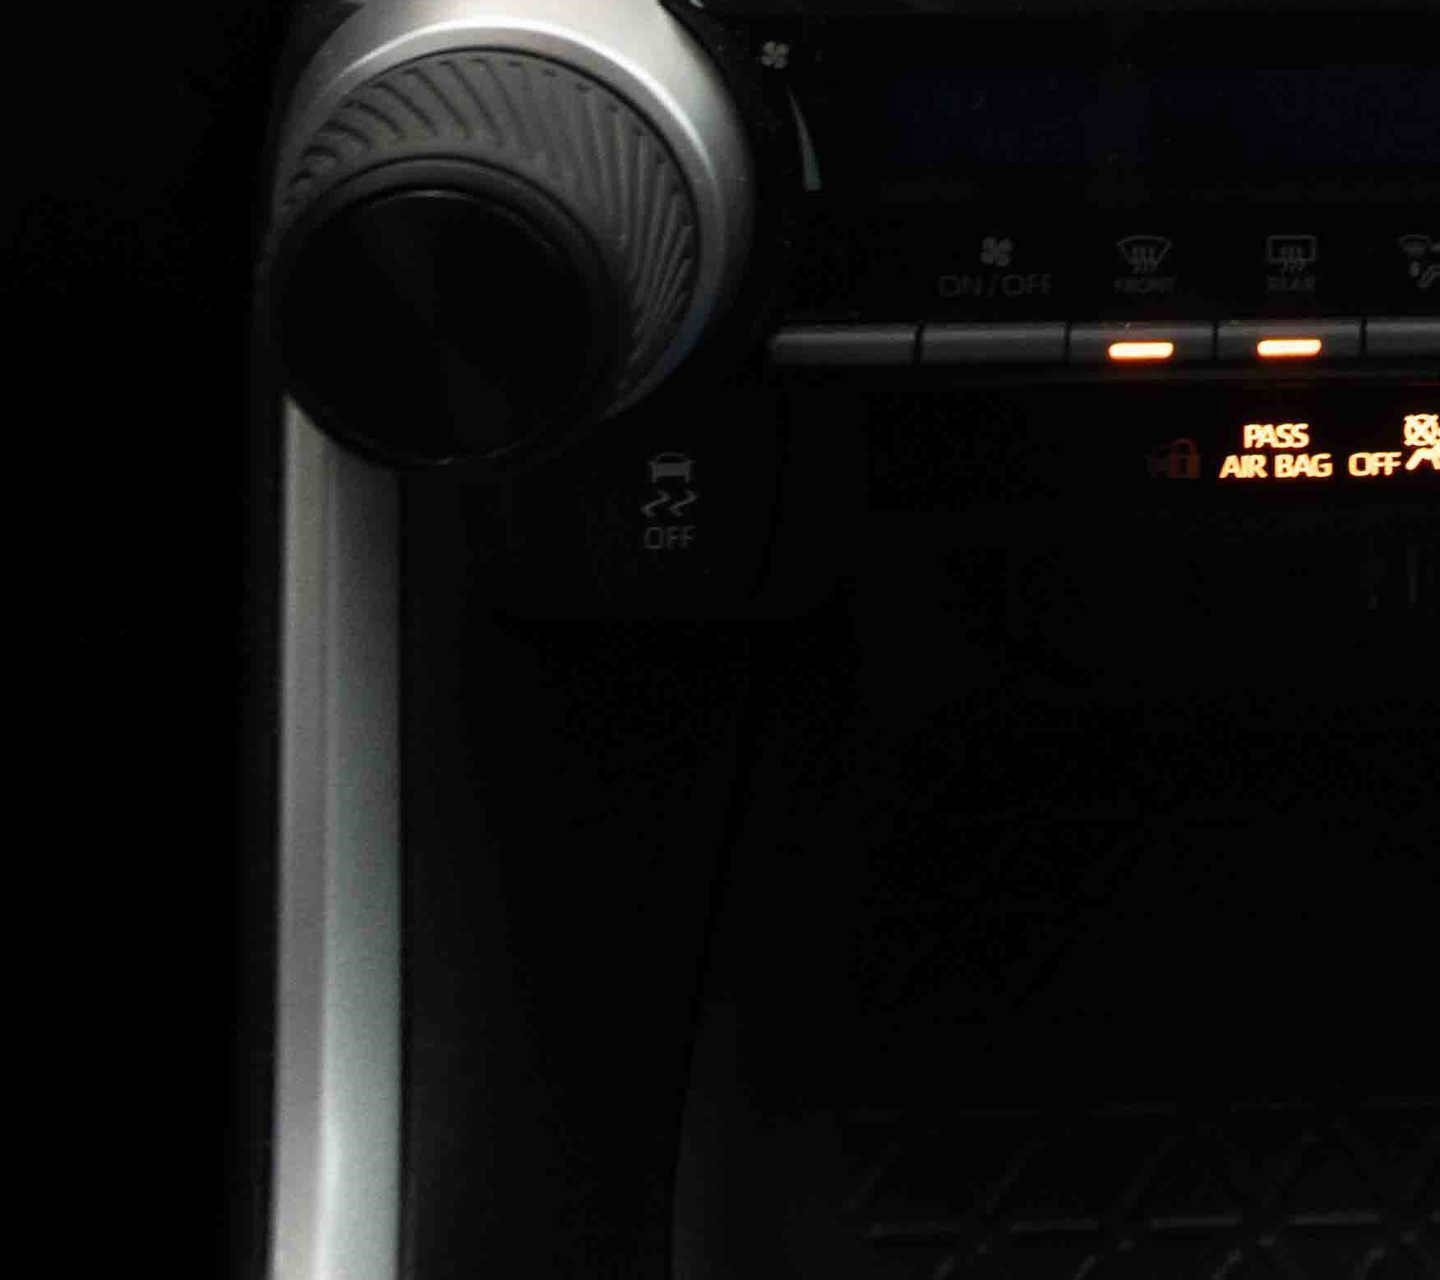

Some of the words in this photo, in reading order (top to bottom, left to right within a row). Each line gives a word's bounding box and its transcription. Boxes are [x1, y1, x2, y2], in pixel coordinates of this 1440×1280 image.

[937, 273, 1053, 297] ON/OFF
[1243, 423, 1309, 449] PASS
[1218, 453, 1268, 479] AIR
[1274, 453, 1333, 478] BAG
[1348, 452, 1402, 477] OFF
[643, 525, 697, 550] OFF
